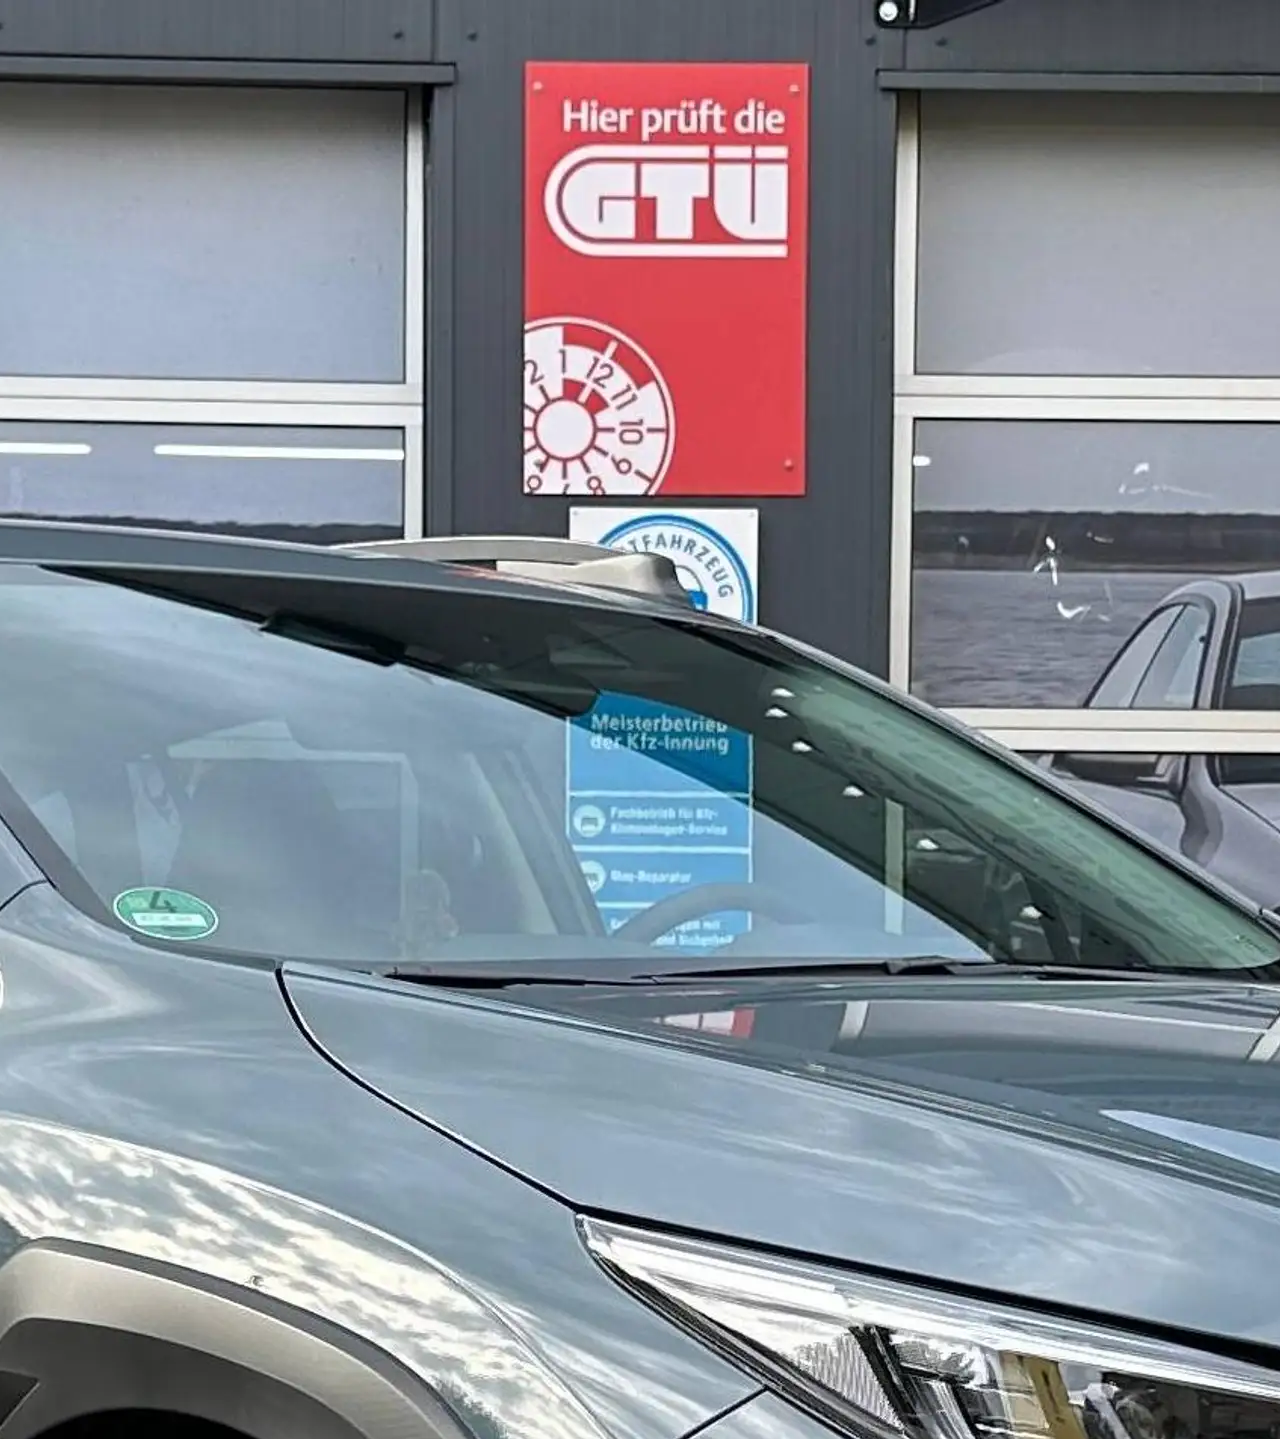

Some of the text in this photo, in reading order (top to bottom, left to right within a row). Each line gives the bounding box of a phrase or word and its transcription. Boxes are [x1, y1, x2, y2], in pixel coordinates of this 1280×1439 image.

[562, 99, 785, 142] Hier prüft die
[545, 144, 788, 257] GTÜ
[627, 531, 734, 599] TFAHRZEUG
